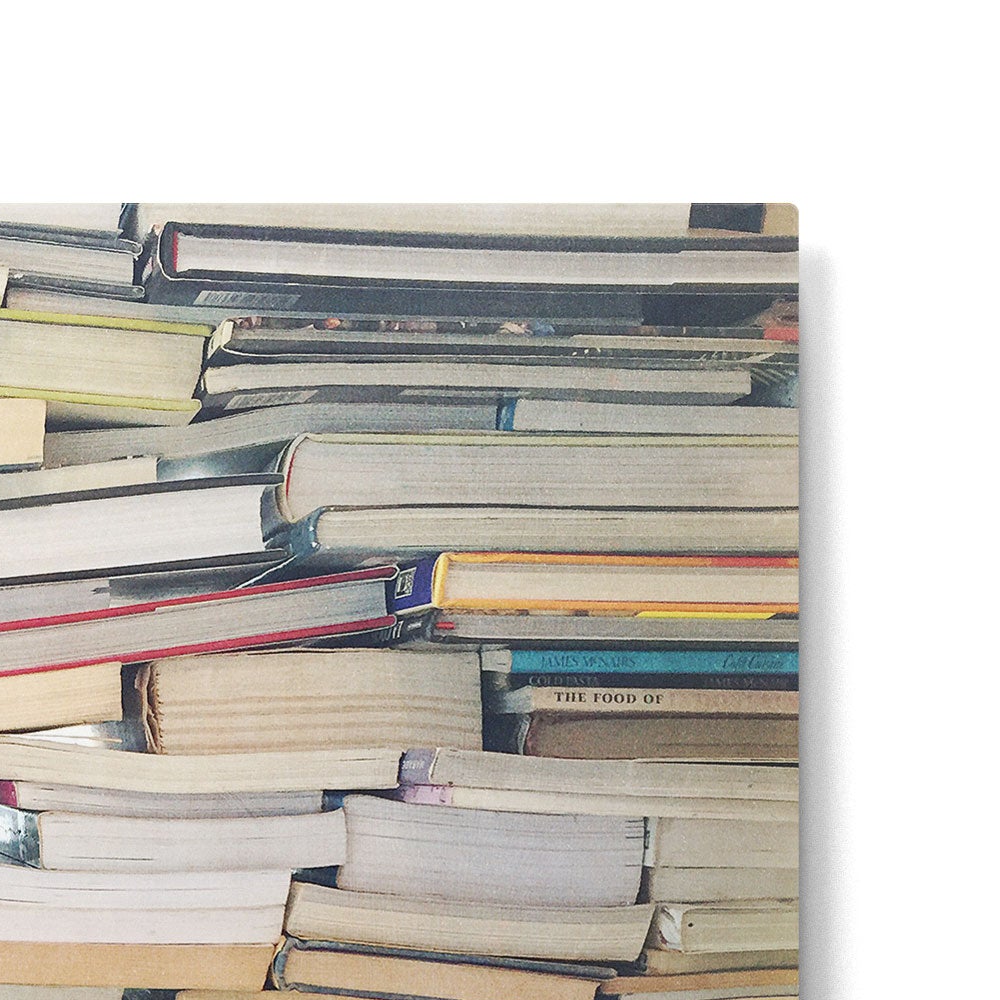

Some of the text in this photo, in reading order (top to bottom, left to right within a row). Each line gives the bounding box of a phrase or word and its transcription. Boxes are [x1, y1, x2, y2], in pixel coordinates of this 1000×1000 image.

[528, 675, 561, 686] COLD
[553, 691, 665, 705] THE FOOD OF
